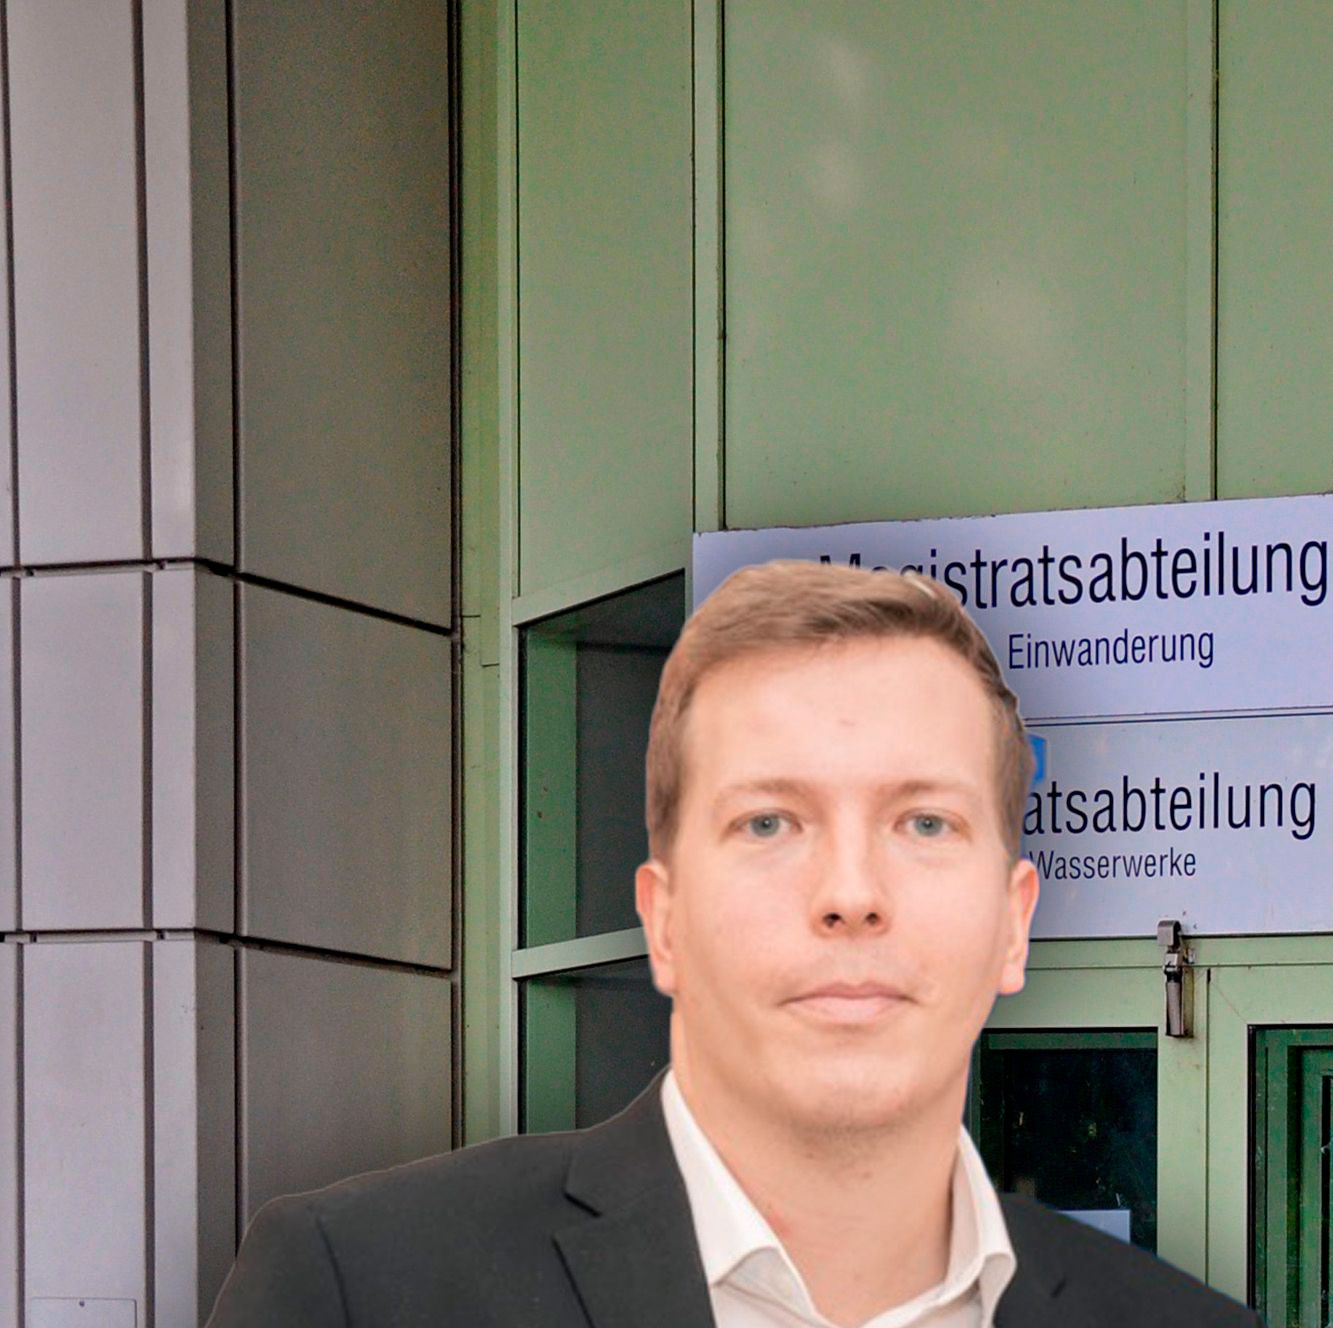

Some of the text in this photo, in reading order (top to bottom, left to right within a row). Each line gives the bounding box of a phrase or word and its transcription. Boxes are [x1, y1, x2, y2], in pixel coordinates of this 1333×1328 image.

[1008, 629, 1214, 669] Einwanderung
[1023, 772, 1316, 841] atsabteilung
[1029, 847, 1197, 881] Wasserwerke
